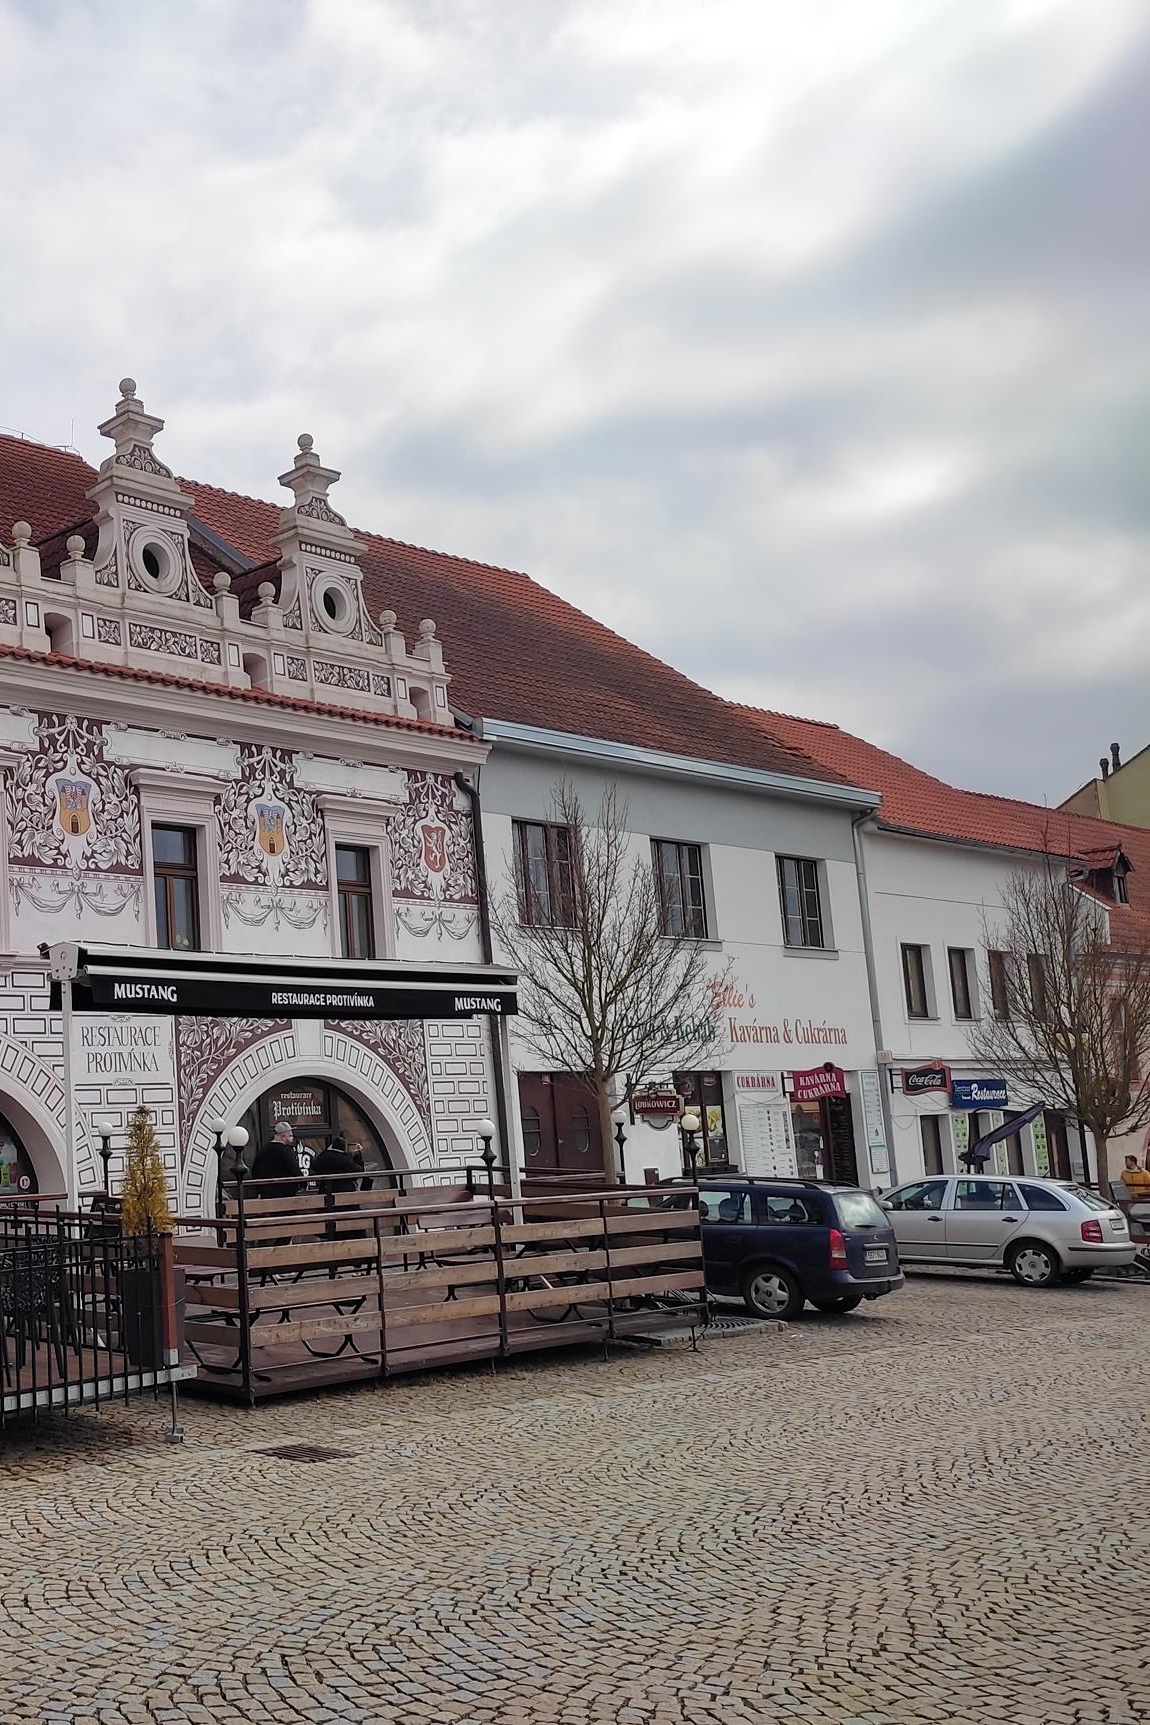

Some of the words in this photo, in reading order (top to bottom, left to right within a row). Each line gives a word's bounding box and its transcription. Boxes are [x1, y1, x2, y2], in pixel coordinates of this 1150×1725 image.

[114, 982, 178, 1002] MUSTANG
[271, 992, 325, 1007] RESTAURACE
[326, 992, 375, 1008] PROTIVÍNKA
[454, 997, 501, 1012] MUSTANG
[81, 1026, 161, 1047] RESTAURACE
[728, 1017, 780, 1044] Kavárna
[783, 1018, 793, 1044] &
[794, 1019, 848, 1045] Cukrárna
[86, 1048, 160, 1074] PROTIVÍNKA
[737, 1073, 776, 1089] CUKRÁRNA
[800, 1072, 837, 1087] KAVÁRNA
[797, 1081, 842, 1099] CUKRÁRNA
[634, 1098, 678, 1109] LOBKOWICZ
